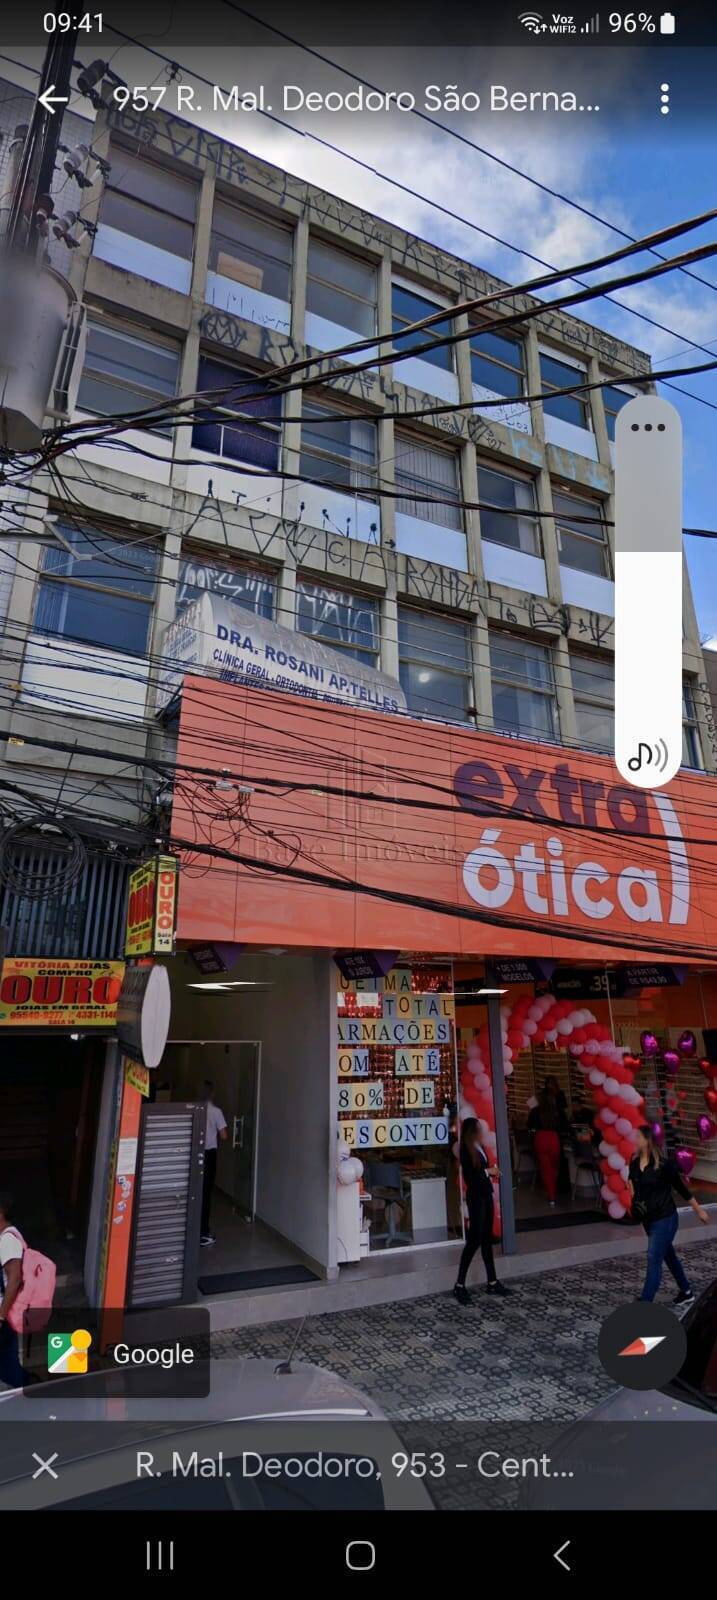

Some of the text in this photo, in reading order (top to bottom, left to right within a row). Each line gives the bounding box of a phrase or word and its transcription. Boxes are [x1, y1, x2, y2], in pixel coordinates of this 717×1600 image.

[213, 649, 244, 671] CLÍNICA
[246, 662, 270, 681] GERAL
[217, 623, 259, 654] DRA.
[265, 645, 325, 683] ROSANI
[453, 761, 651, 834] extra
[158, 871, 175, 930] OURO
[14, 961, 111, 970] VITÓRIA JOIAS
[1, 975, 122, 1005] OURO
[386, 996, 453, 1017] TOTAL
[396, 1051, 439, 1073] ATÉ
[338, 1086, 433, 1108] 80% DE
[337, 1122, 448, 1145] ESCONTO
